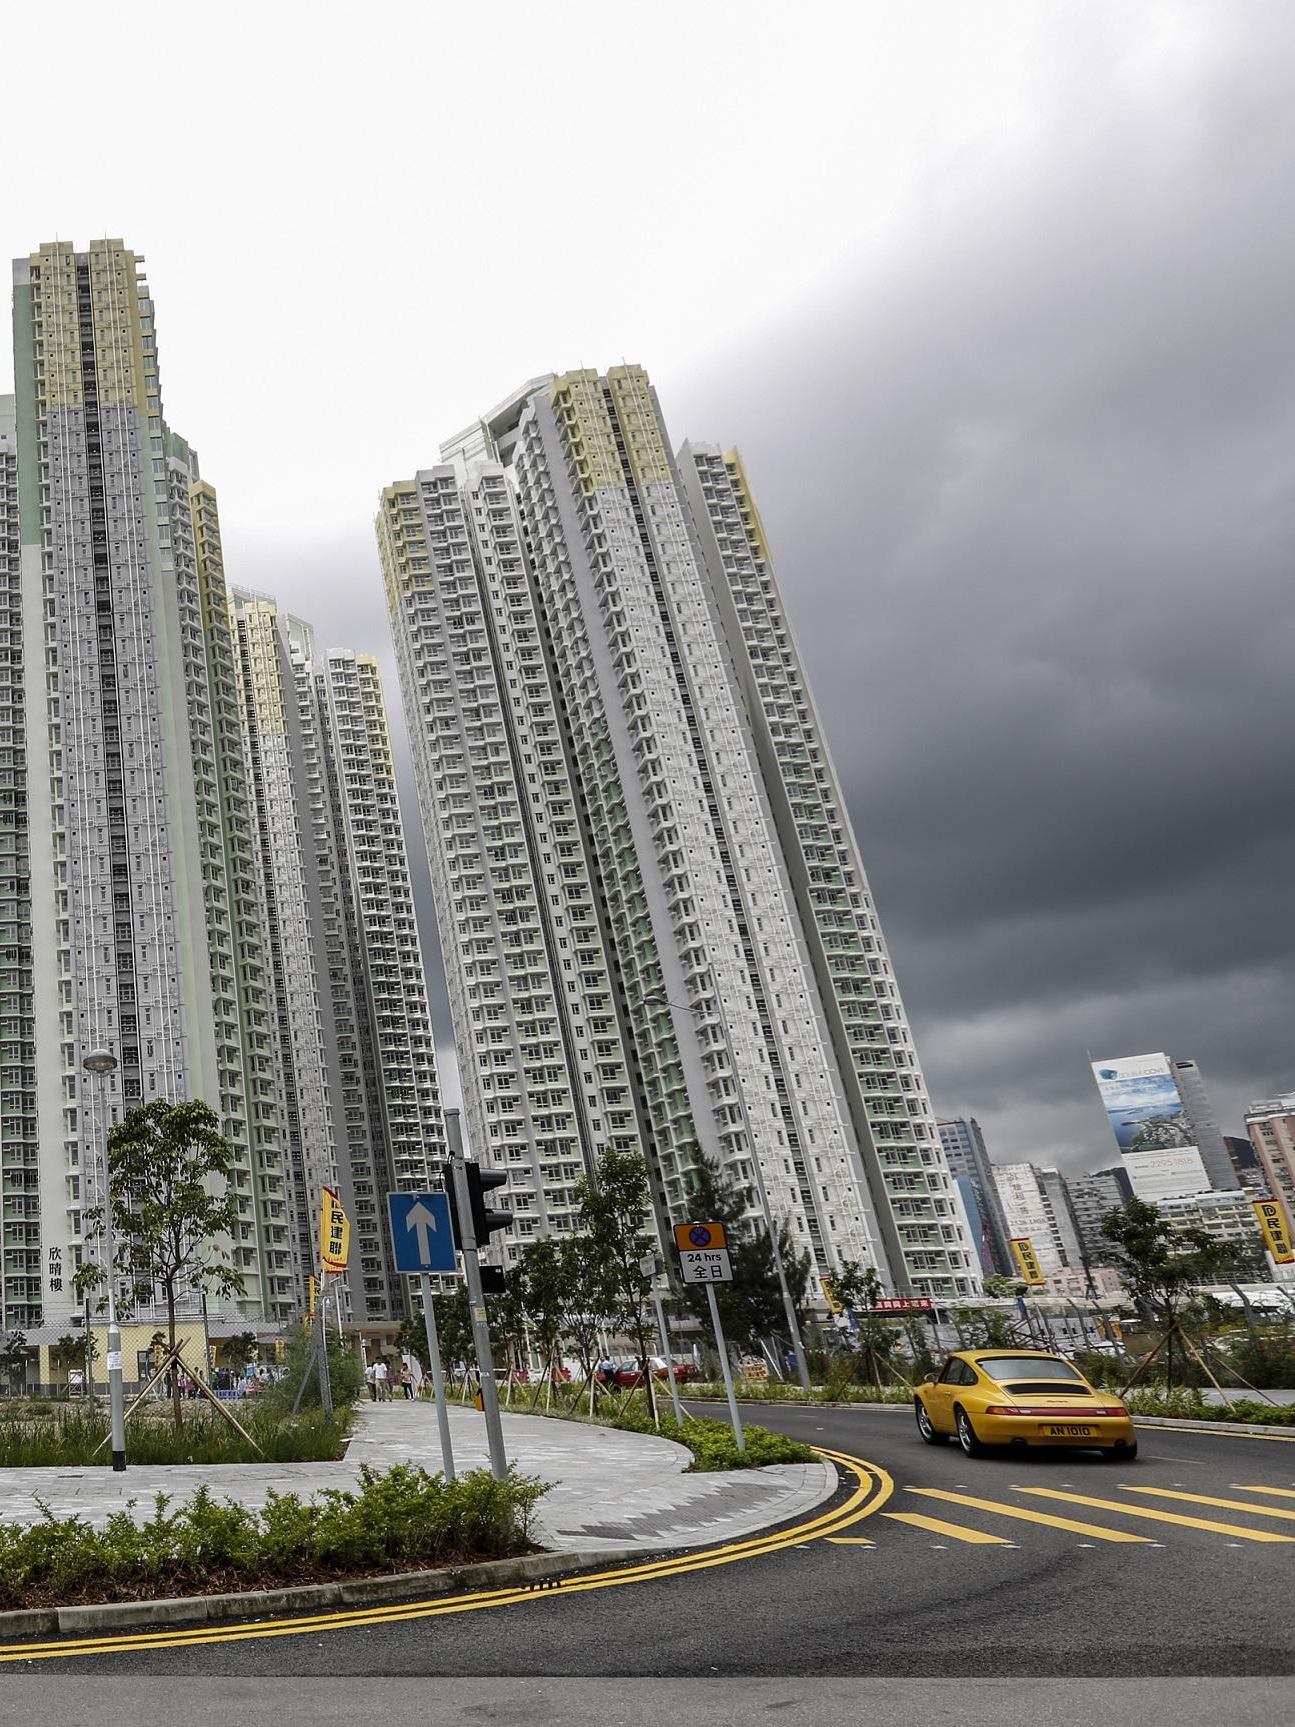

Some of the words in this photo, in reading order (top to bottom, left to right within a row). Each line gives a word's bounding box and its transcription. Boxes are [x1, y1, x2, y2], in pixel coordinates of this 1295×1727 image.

[329, 1211, 343, 1255] 民建聯
[687, 1254, 702, 1262] 24
[705, 1253, 722, 1261] hrs
[49, 1247, 63, 1292] 欣晴樓
[693, 1265, 723, 1278] 全日
[1050, 1427, 1064, 1436] AN
[1067, 1426, 1090, 1436] 1010
